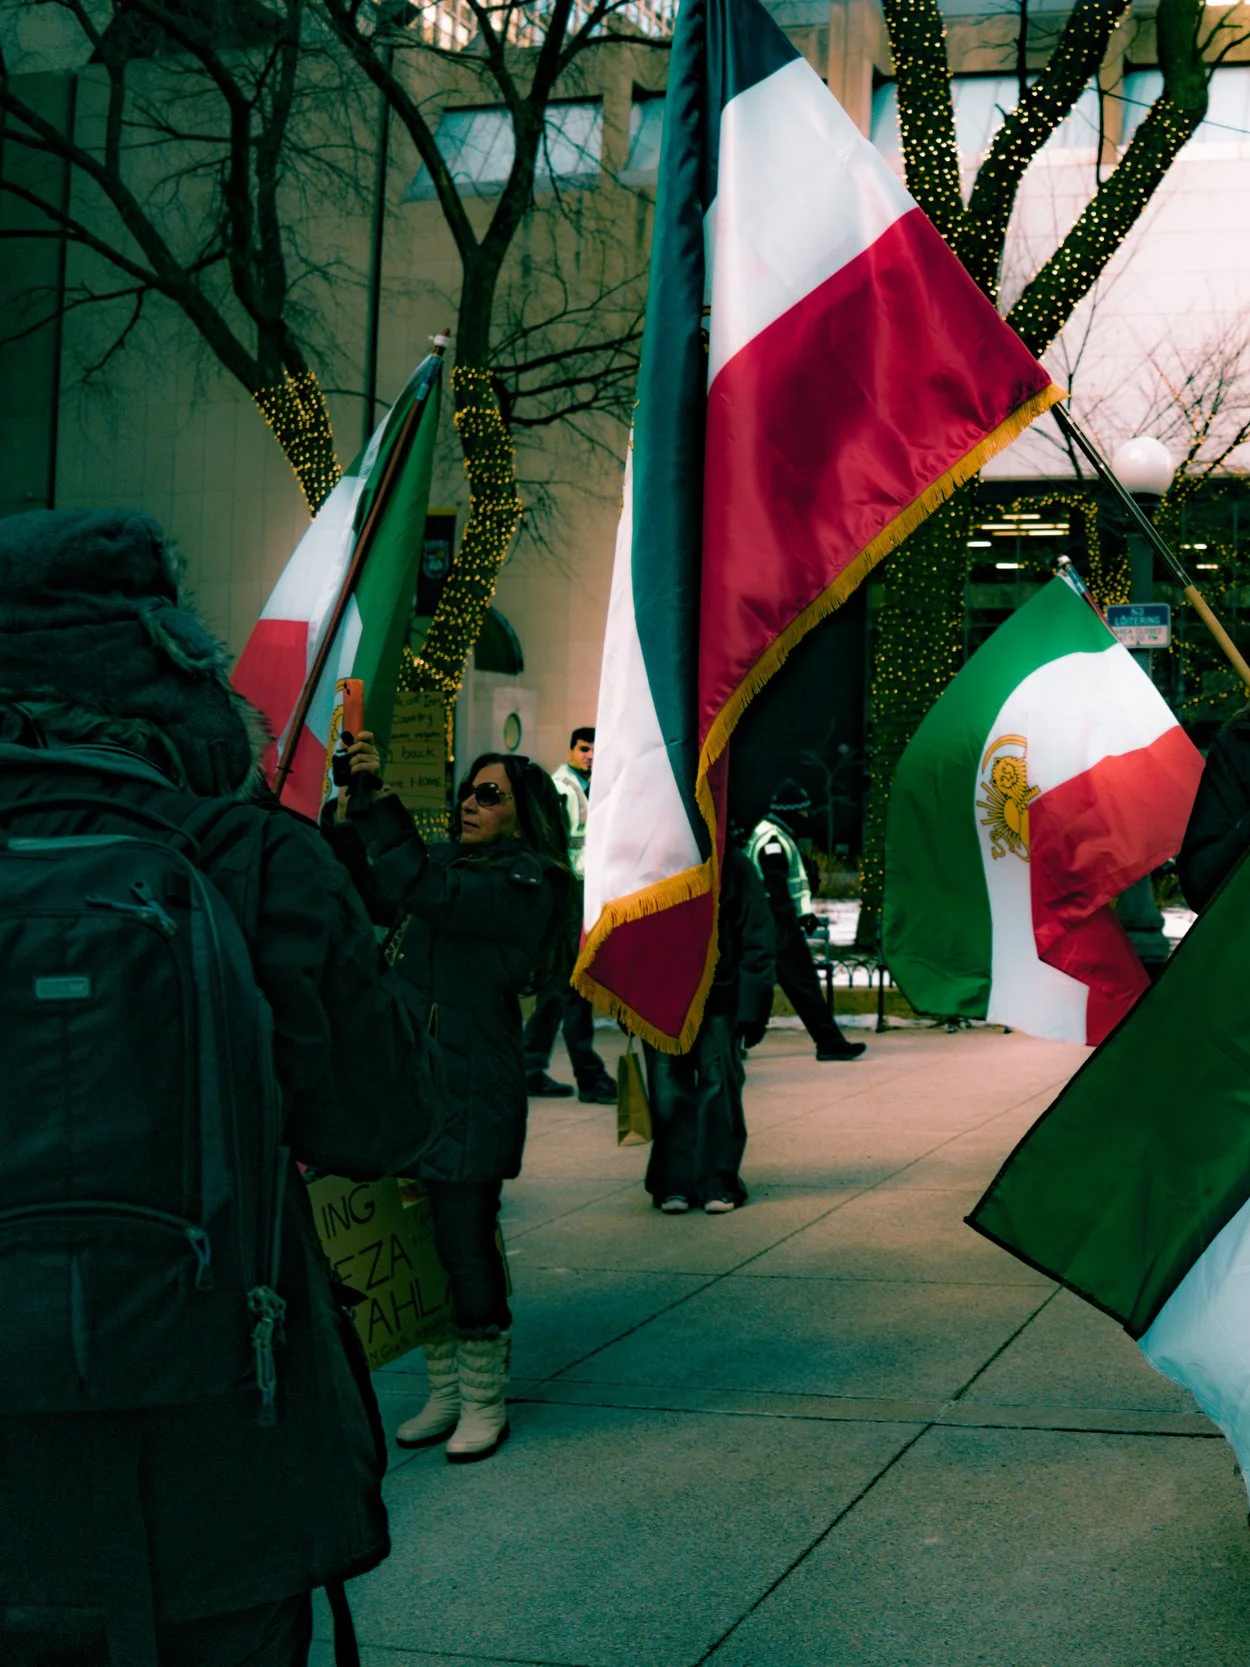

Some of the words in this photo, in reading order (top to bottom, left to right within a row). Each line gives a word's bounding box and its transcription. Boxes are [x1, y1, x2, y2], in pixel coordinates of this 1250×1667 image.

[1130, 608, 1144, 616] NO
[1114, 615, 1160, 625] LOITERING
[401, 745, 435, 760] back
[410, 775, 441, 788] HOME
[321, 1183, 376, 1240] ING
[367, 1277, 452, 1344] AHL
